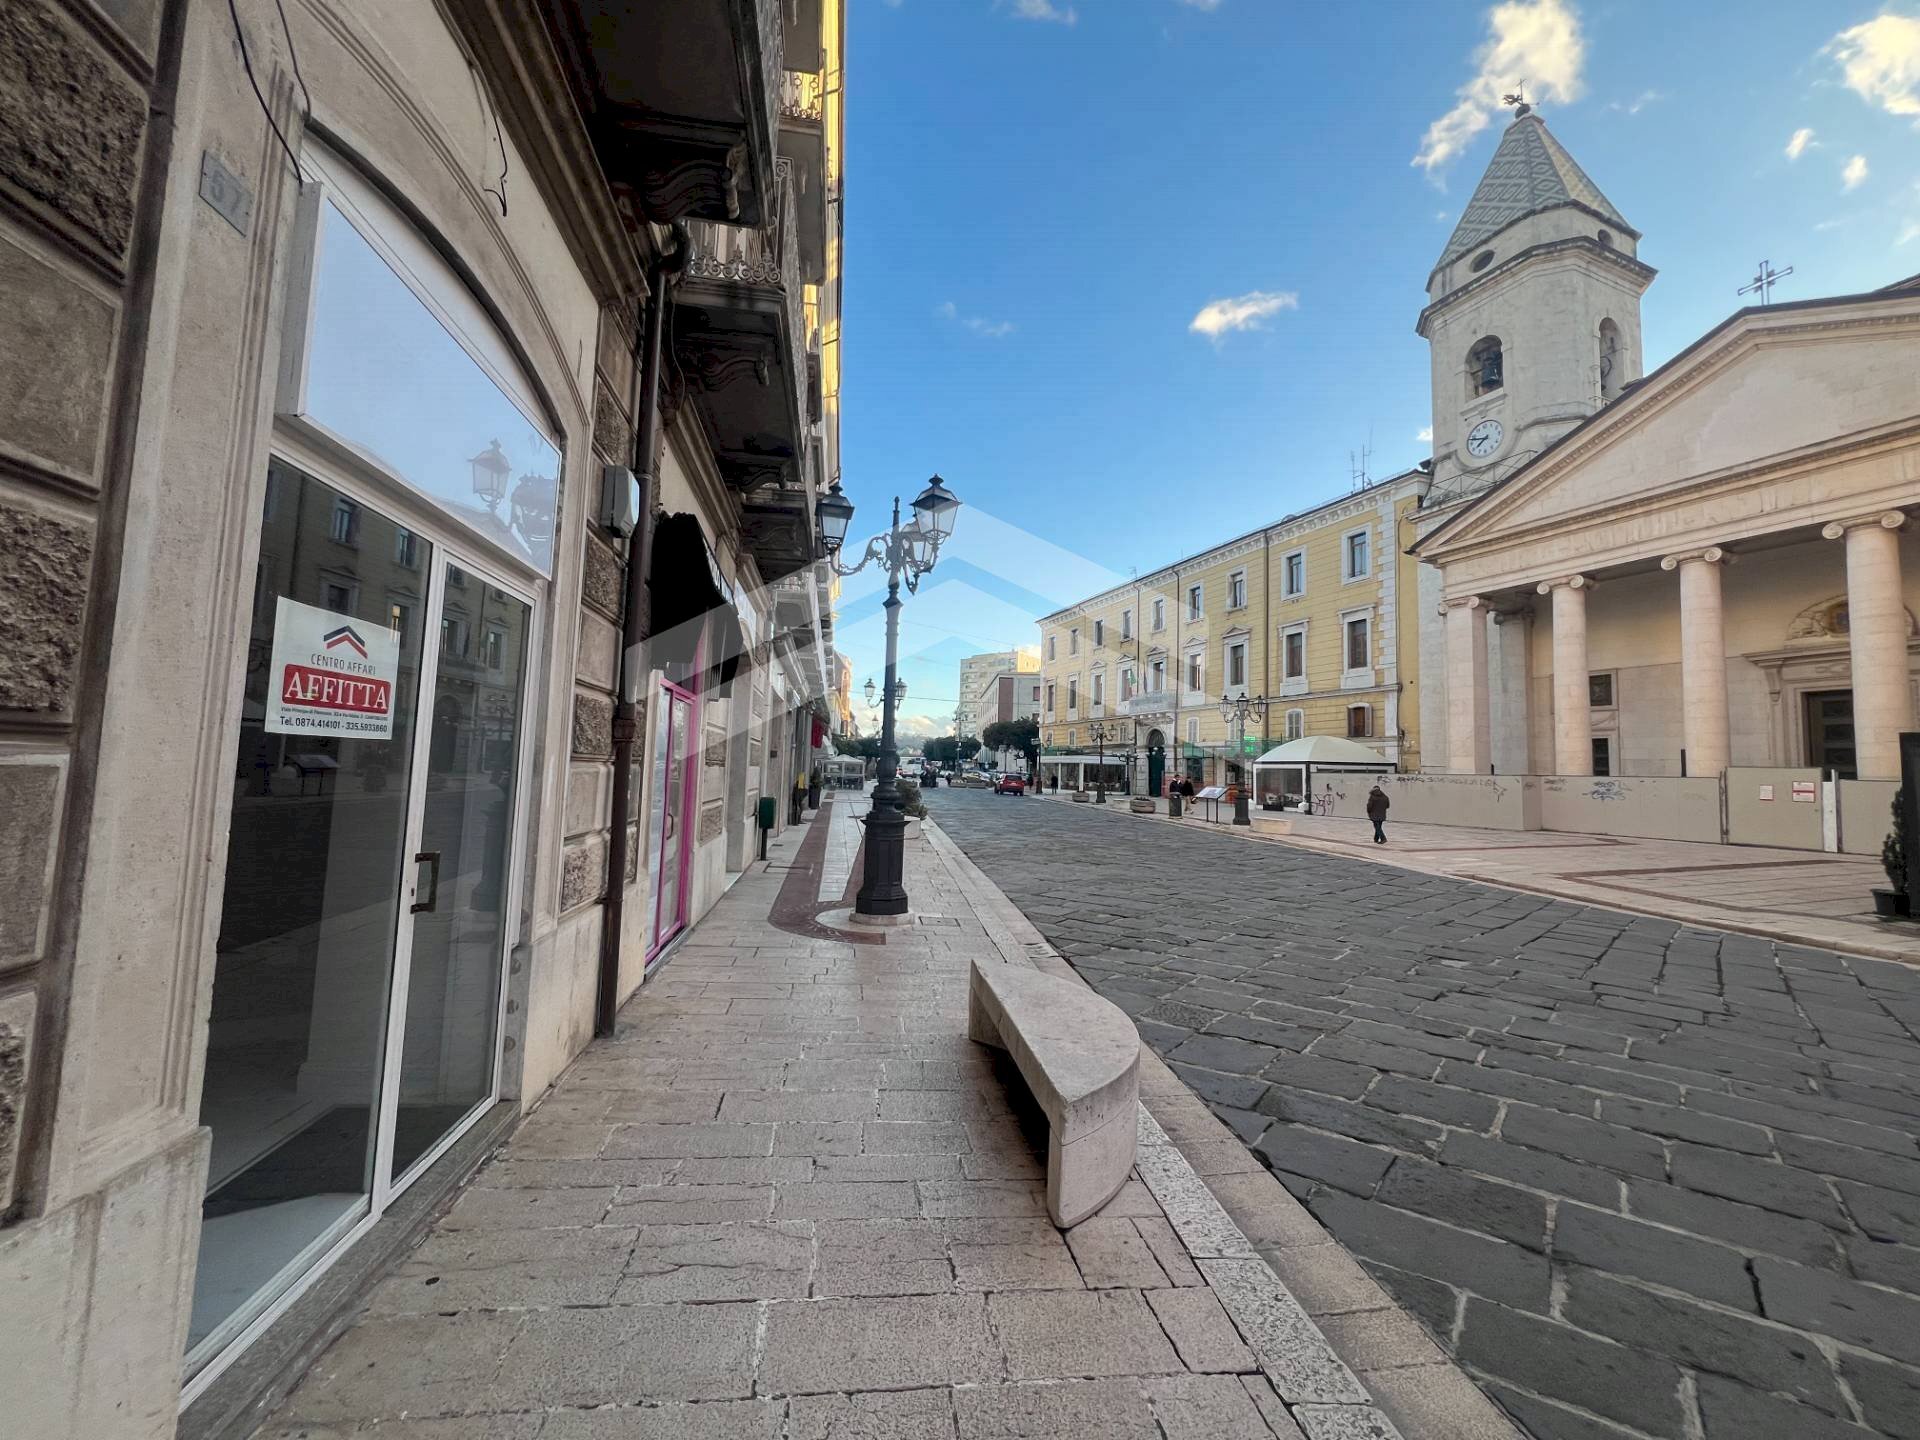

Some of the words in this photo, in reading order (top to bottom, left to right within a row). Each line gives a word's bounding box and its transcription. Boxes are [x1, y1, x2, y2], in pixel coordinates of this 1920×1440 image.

[311, 653, 345, 670] CENTRO
[347, 661, 376, 676] AFFARI
[284, 671, 387, 709] AFFITTA
